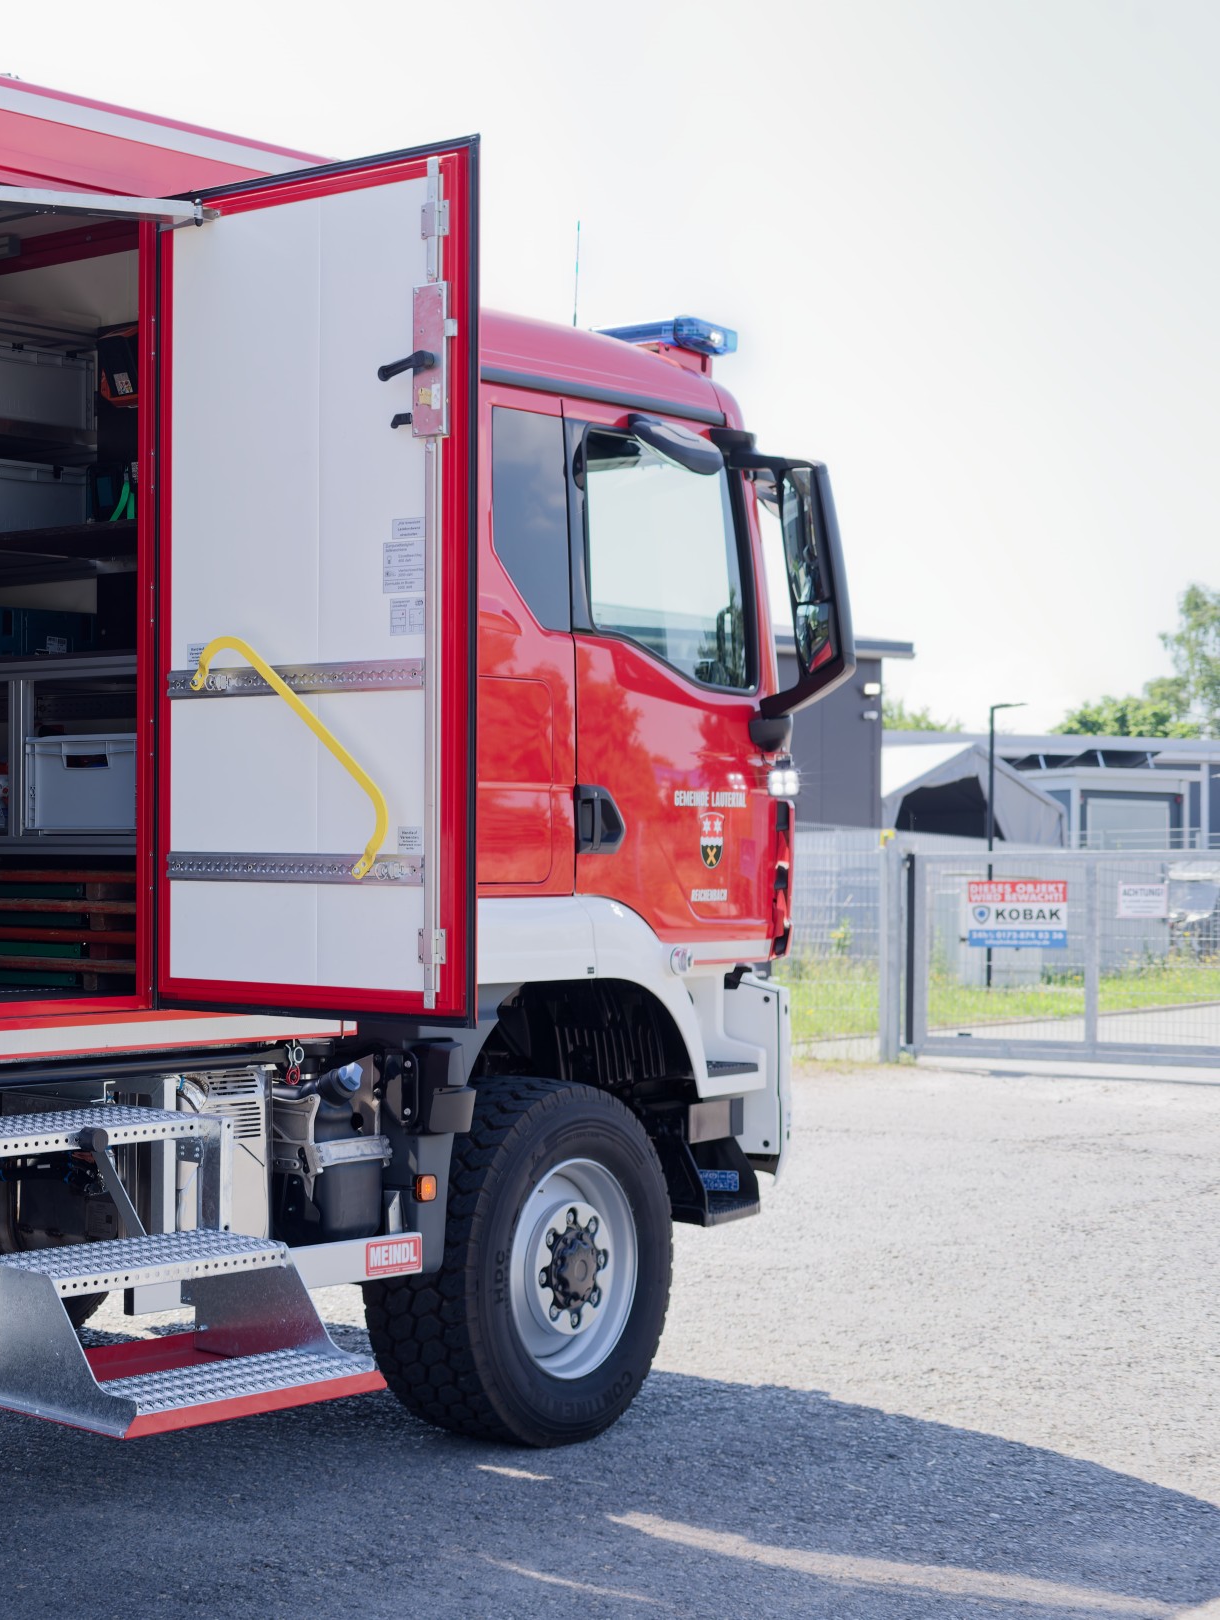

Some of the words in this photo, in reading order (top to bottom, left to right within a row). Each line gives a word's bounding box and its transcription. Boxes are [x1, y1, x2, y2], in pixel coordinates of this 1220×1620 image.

[674, 789, 710, 807] GEMEINDE
[711, 791, 747, 808] LAUTERTAL
[969, 883, 1012, 893] DIESES
[1015, 883, 1065, 893] OBJEKT
[970, 893, 1002, 902] WIRD
[1004, 893, 1064, 902] BEWACHT!
[995, 908, 1061, 921] KOBAK
[369, 1241, 418, 1268] MEINDL
